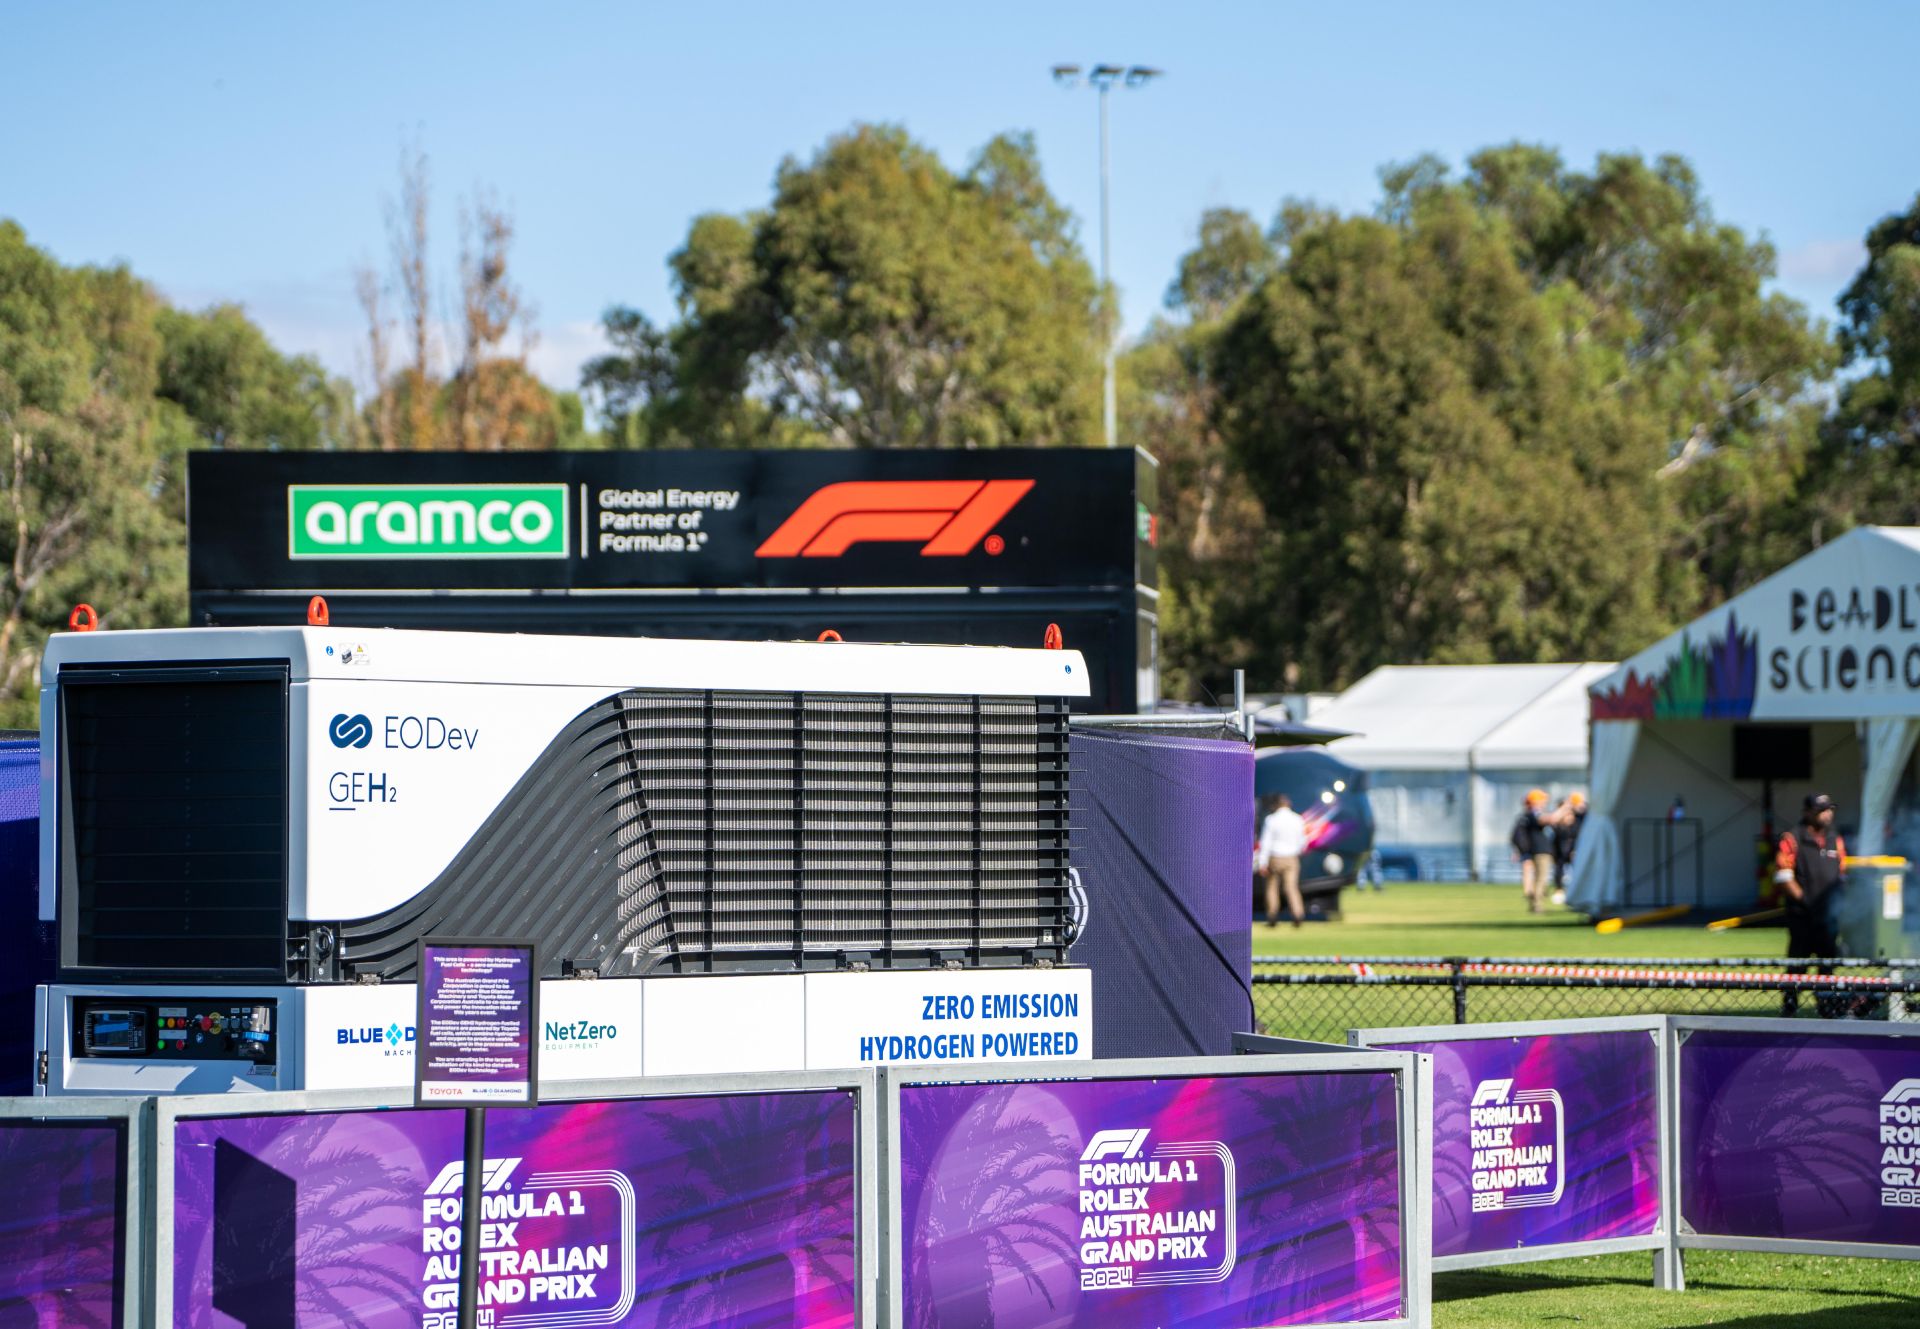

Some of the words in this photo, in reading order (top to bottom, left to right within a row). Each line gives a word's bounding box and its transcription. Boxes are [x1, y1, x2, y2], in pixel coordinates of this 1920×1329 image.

[599, 489, 664, 509] Global
[666, 489, 740, 511] Energy
[305, 500, 554, 545] aramco
[600, 511, 677, 530] Partner
[677, 510, 703, 530] of
[600, 532, 685, 552] Formula
[385, 715, 479, 750] EODev
[922, 995, 974, 1020] ZERO
[981, 993, 1078, 1019] EMISSION
[337, 1027, 383, 1044] BLUE
[545, 1020, 617, 1040] NetZero
[545, 1042, 599, 1050] EQUIPMENT
[860, 1034, 975, 1061] HYDROGEN
[982, 1031, 1079, 1057] POWERED
[1470, 1105, 1533, 1127] FORMULA
[1533, 1104, 1543, 1123] 1
[1471, 1127, 1514, 1149] ROLEX
[1471, 1145, 1553, 1170] AUSTRALIAN
[1079, 1161, 1183, 1186] FORMULA
[1186, 1160, 1198, 1182] 1
[1471, 1168, 1517, 1190] GRAND
[1517, 1166, 1554, 1187] PRIX
[423, 1192, 565, 1224] FOMULA
[569, 1190, 585, 1215] 1
[1079, 1187, 1149, 1213] ROLEX
[423, 1222, 519, 1252] ROEX
[1080, 1210, 1216, 1239] AUSTRALIAN
[1080, 1239, 1155, 1265] GRAND
[1158, 1235, 1208, 1260] PRIX
[422, 1245, 608, 1281] AUTRALIAN
[530, 1273, 597, 1302] PRIX
[1081, 1266, 1133, 1291] 2024
[423, 1308, 495, 1329] 204
